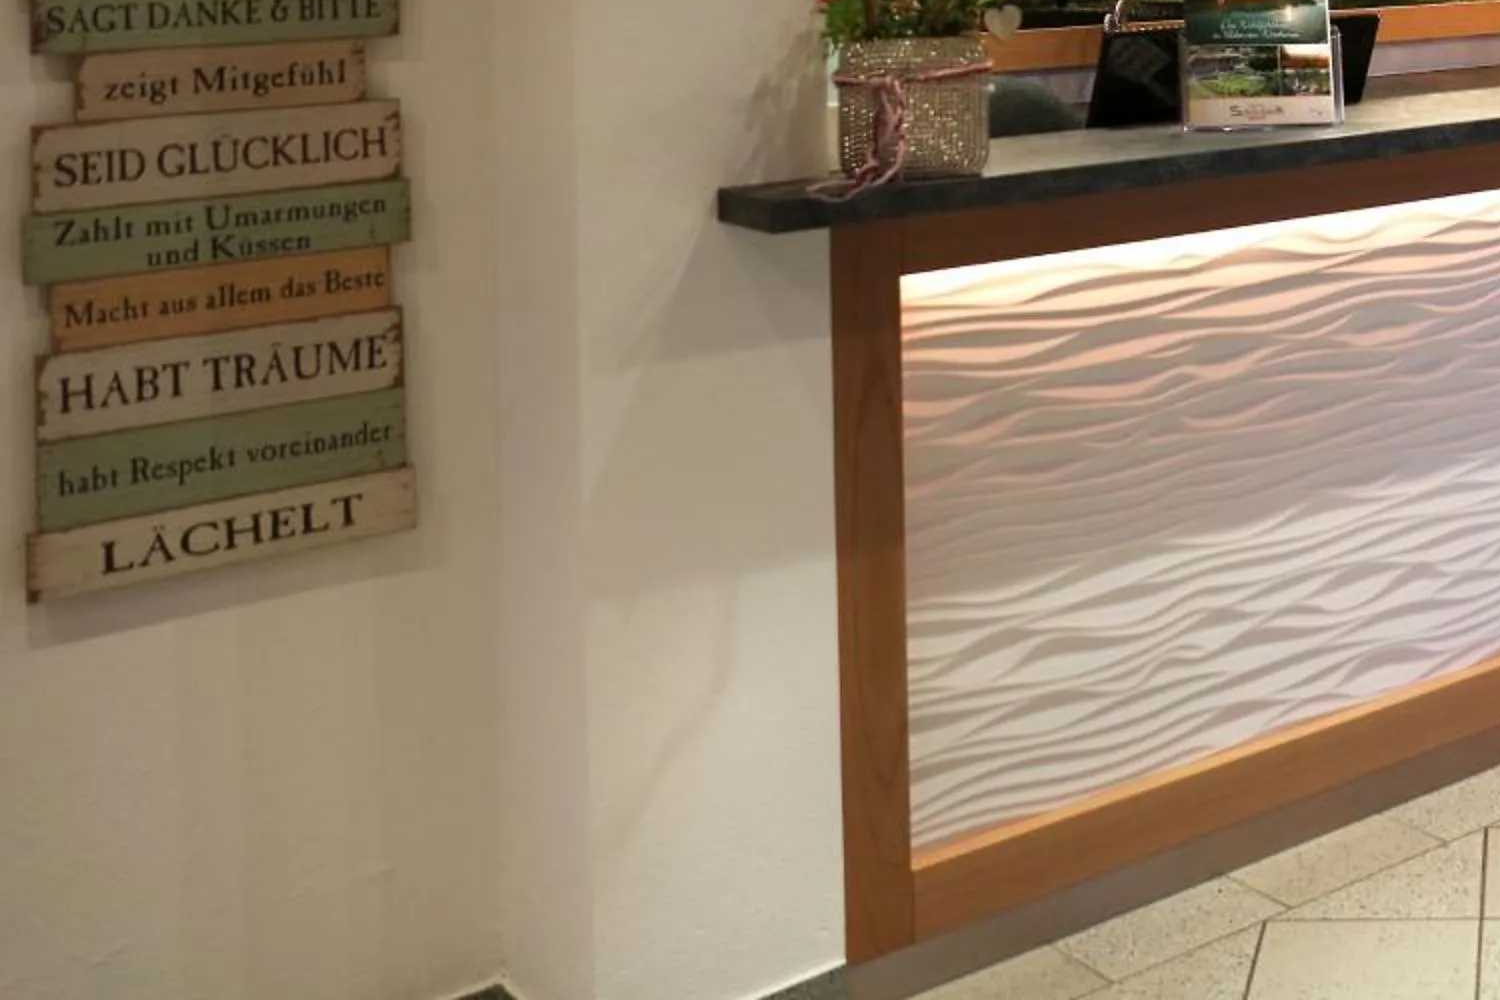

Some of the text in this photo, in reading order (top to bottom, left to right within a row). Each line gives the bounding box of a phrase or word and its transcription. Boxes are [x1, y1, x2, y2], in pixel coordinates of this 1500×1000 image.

[46, 3, 138, 36] SAGT
[103, 58, 346, 104] zeigt Mitgefühl
[53, 126, 389, 188] SEID GLÜCKLICH
[54, 198, 387, 247] Zahlt mit Umarmungen
[147, 243, 199, 268] und
[64, 267, 385, 329] Macht aus allem das Beste
[58, 335, 389, 414] HABT TRÄUME
[58, 422, 396, 497] habt Respekt voreinander
[100, 493, 363, 576] LÄCHELT
